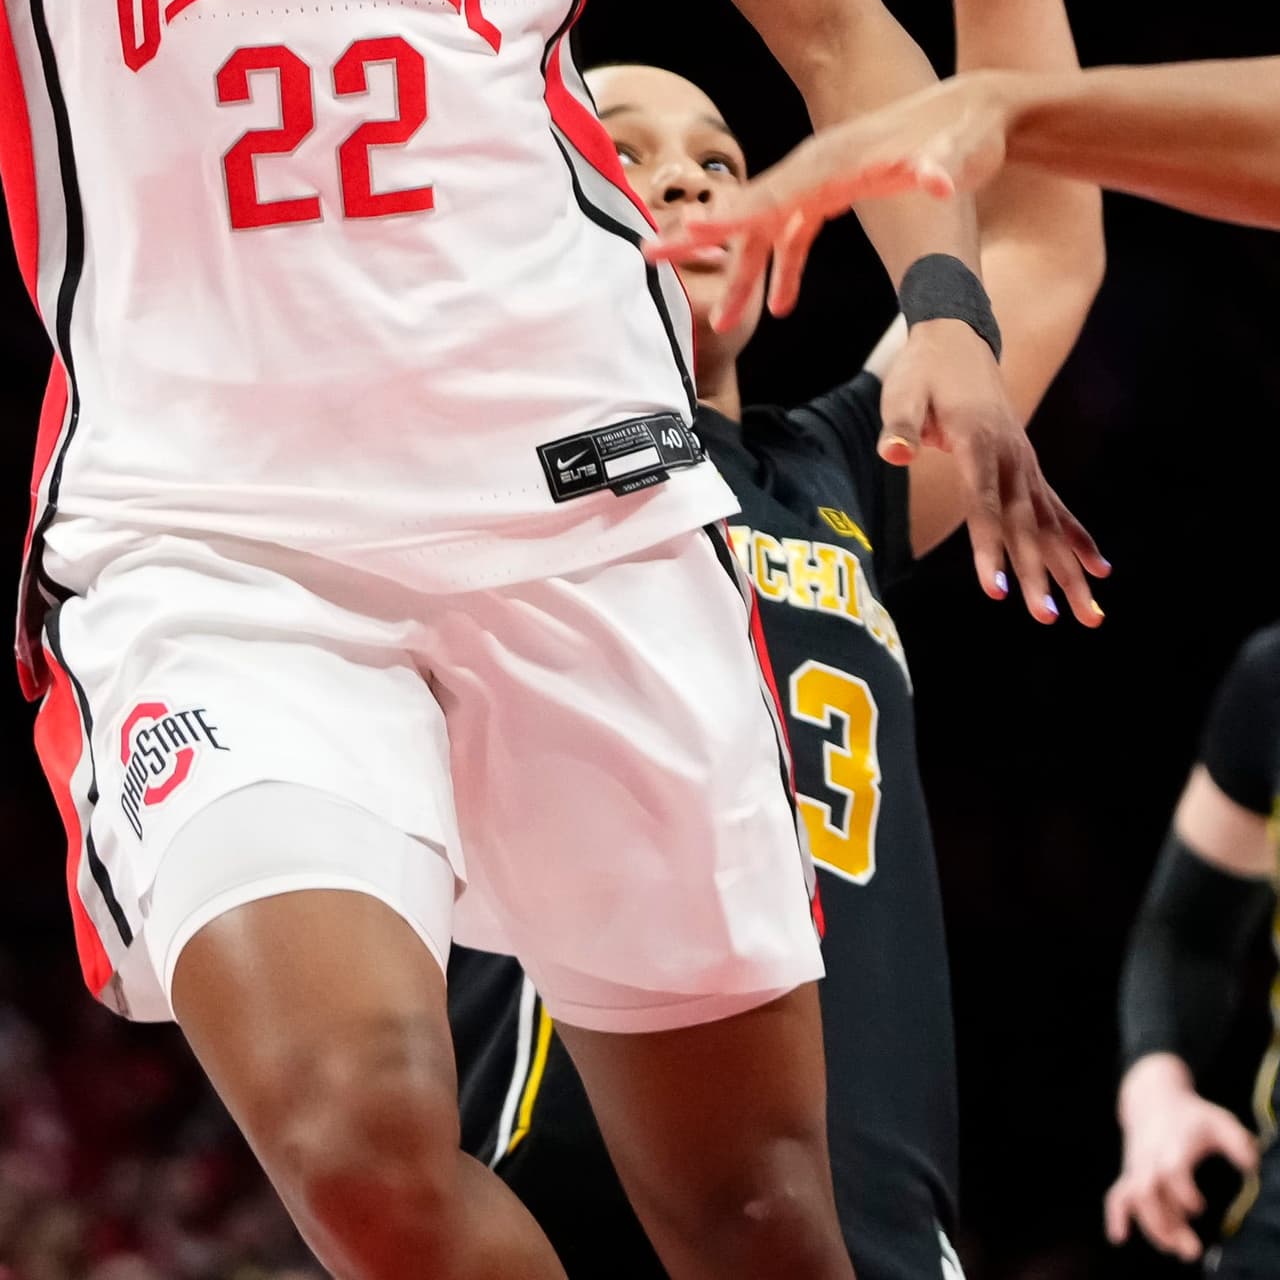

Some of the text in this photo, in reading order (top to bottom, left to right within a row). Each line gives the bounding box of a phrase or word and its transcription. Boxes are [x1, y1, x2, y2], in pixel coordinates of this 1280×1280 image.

[215, 34, 436, 232] 22
[661, 427, 683, 449] 40
[789, 659, 882, 886] 3
